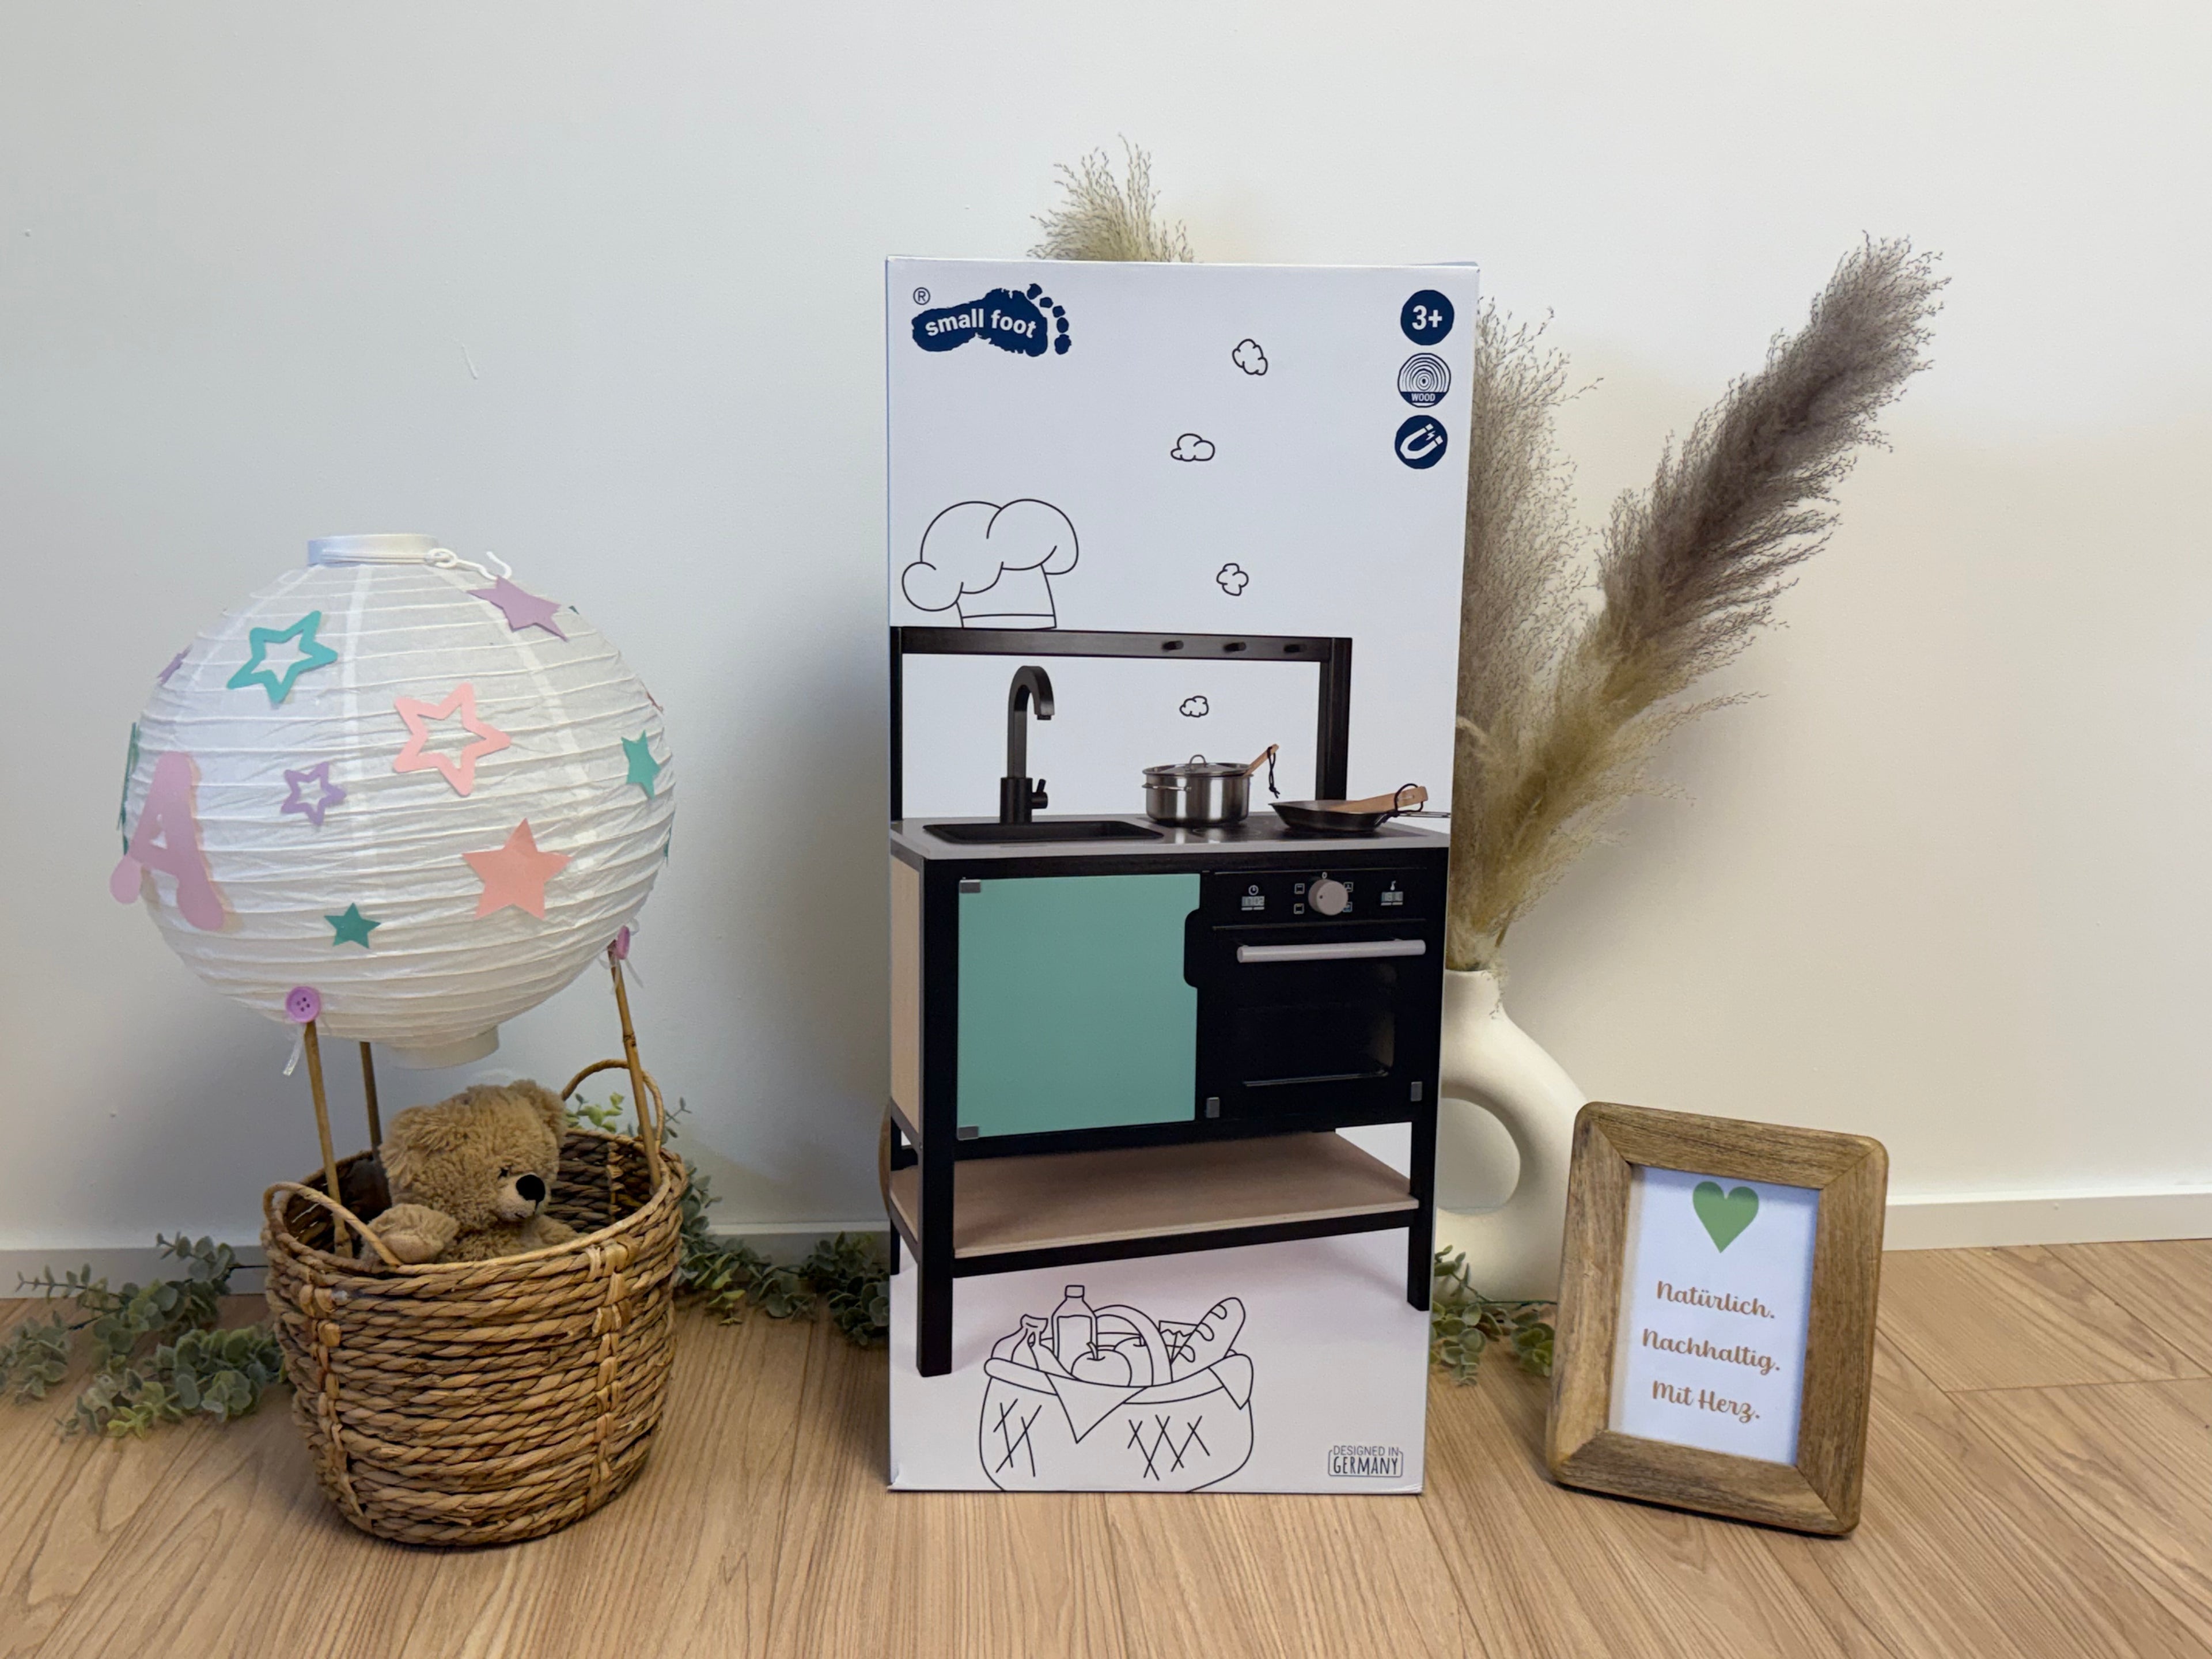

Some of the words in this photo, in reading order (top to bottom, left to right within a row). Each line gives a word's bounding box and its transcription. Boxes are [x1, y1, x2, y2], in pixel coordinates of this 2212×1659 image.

[925, 308, 984, 336] small
[991, 309, 1036, 338] foot
[1412, 305, 1442, 330] 3+
[1411, 393, 1435, 402] WOOD
[109, 751, 226, 932] A
[1657, 1281, 1775, 1319] Natürlich.
[1642, 1328, 1780, 1376] Nachhaltig.
[1652, 1380, 1694, 1406] Mit
[1698, 1389, 1760, 1423] Herz.
[1333, 1445, 1385, 1456] DESIGNED
[1388, 1446, 1399, 1457] IN
[1334, 1456, 1398, 1475] GERMANY
